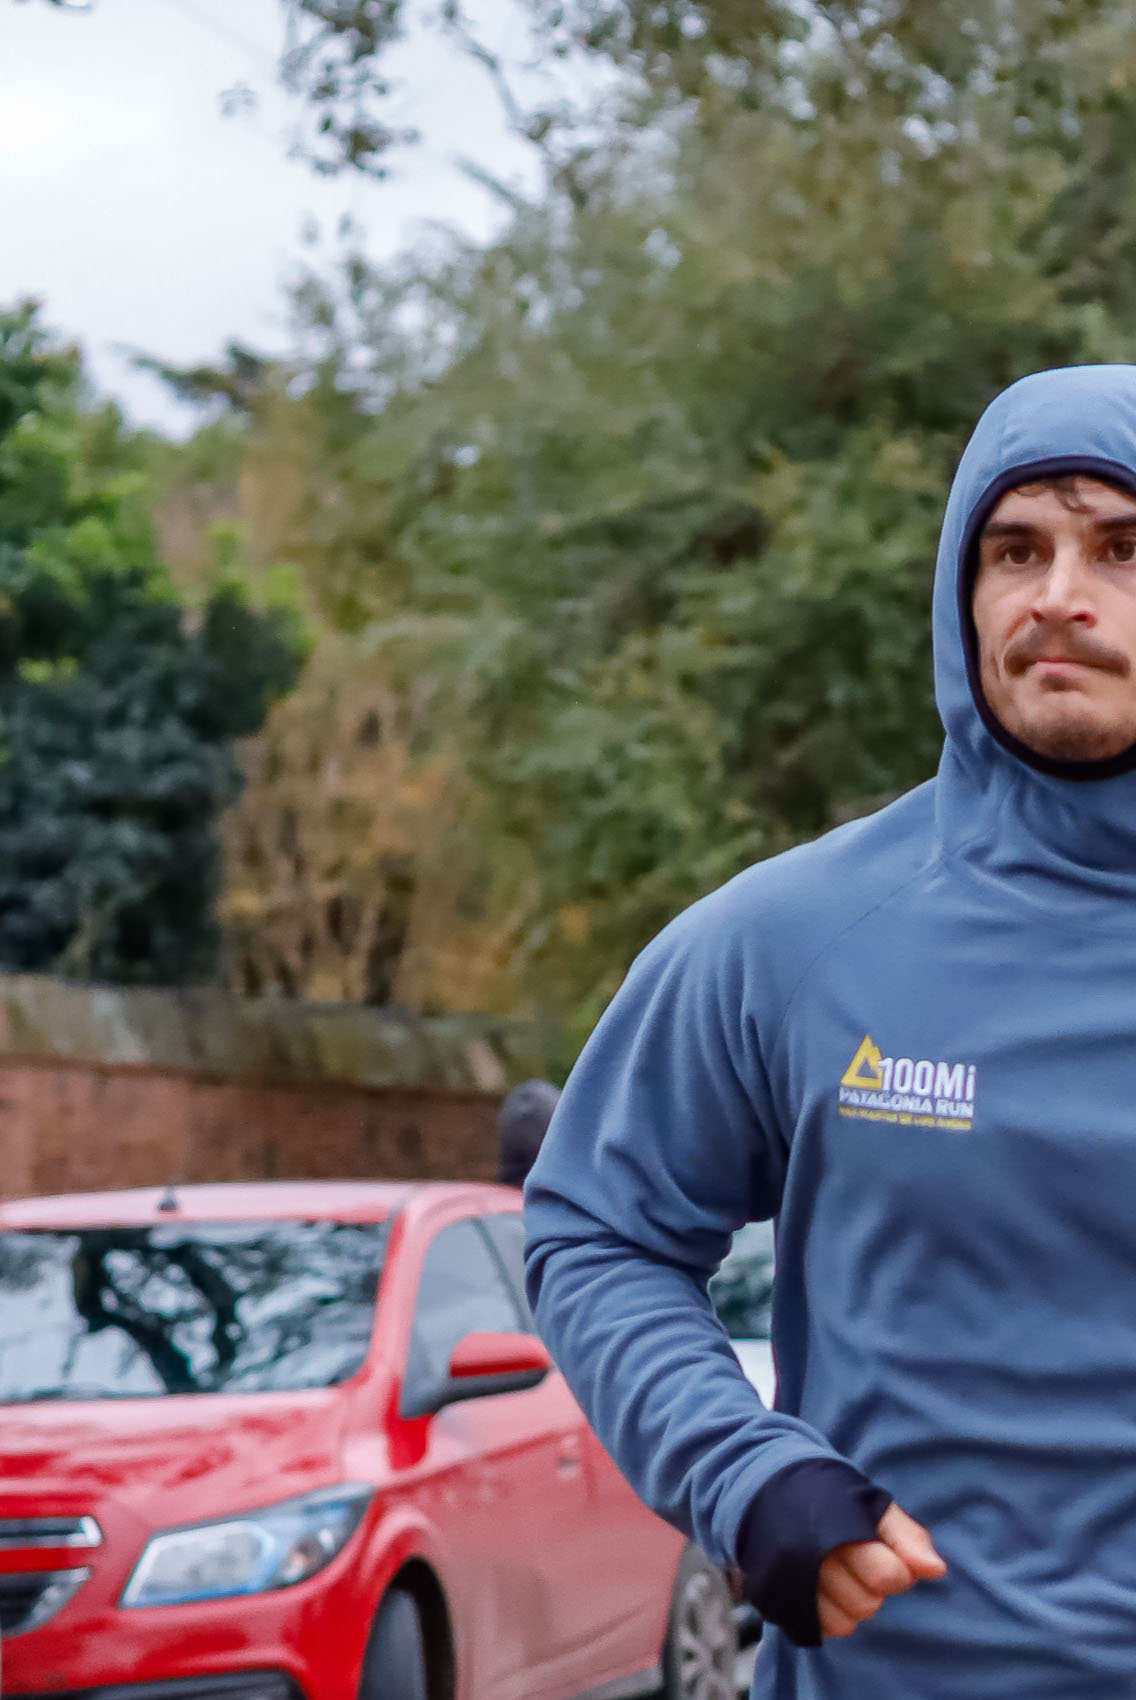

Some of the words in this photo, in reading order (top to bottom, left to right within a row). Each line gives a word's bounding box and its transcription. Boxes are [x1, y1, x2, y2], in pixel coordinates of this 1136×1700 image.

[878, 1057, 976, 1101] 100Mi
[839, 1087, 933, 1113] PATAGONIA
[936, 1098, 974, 1119] RUN
